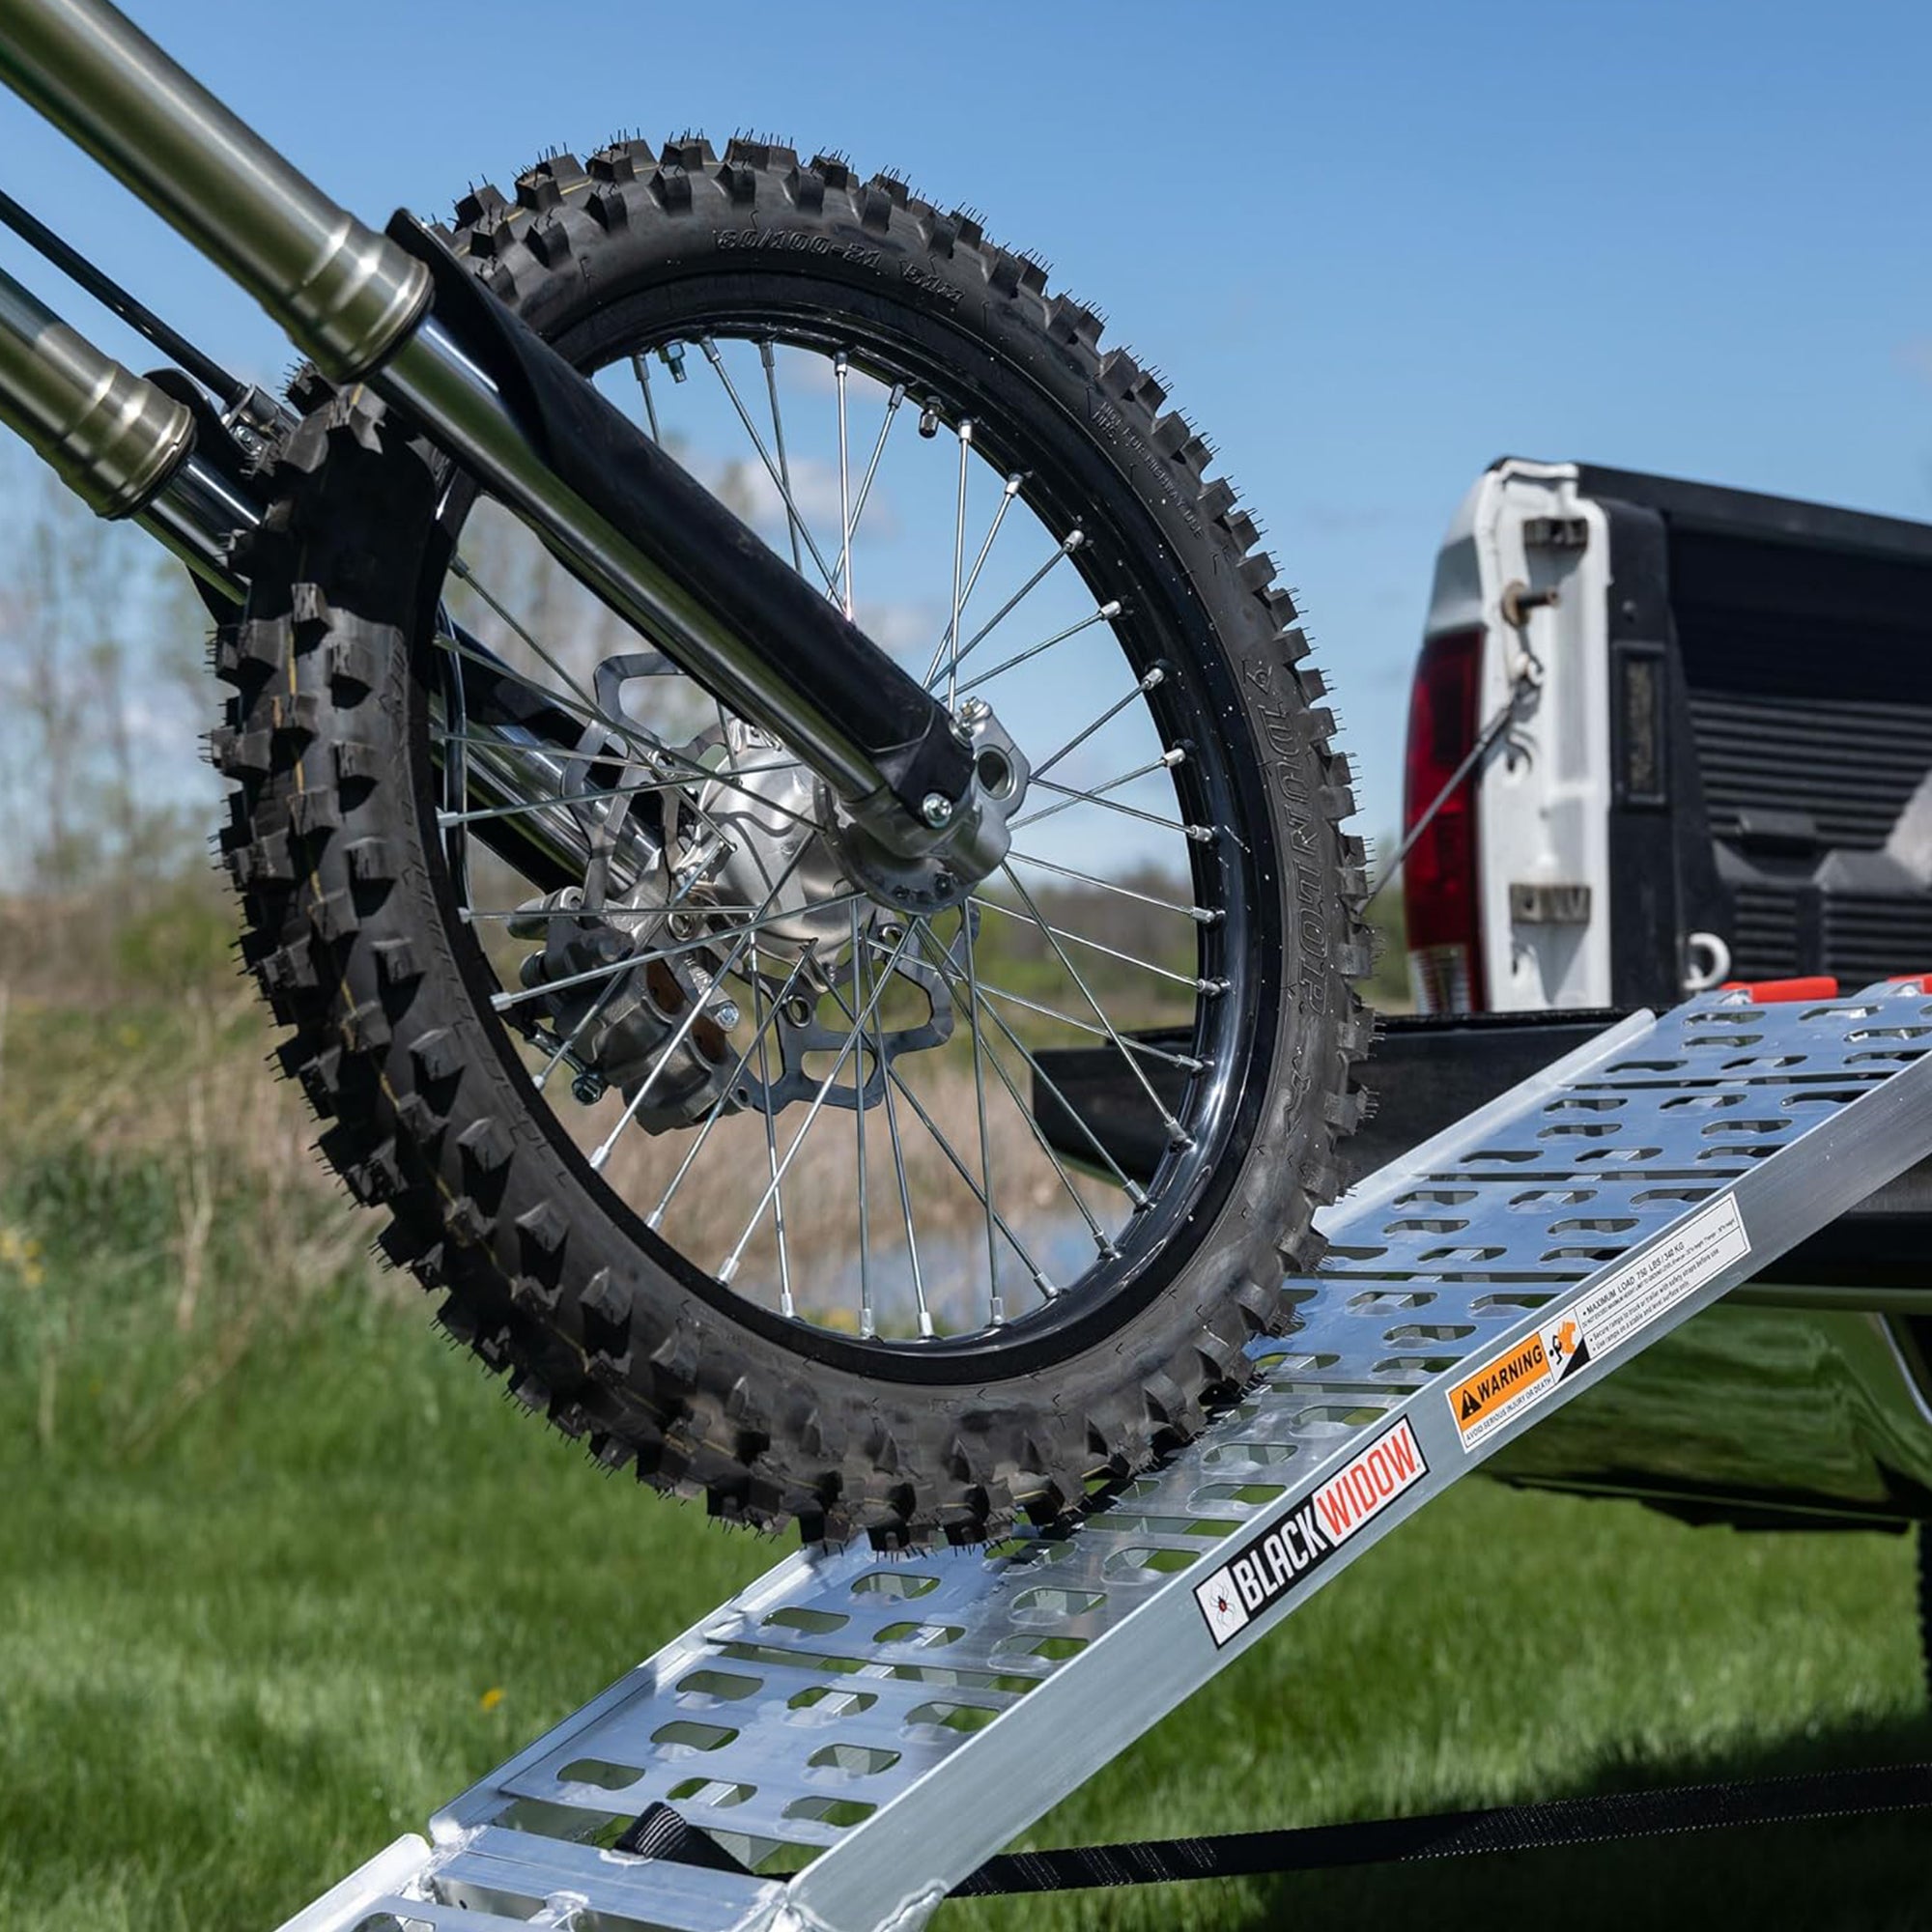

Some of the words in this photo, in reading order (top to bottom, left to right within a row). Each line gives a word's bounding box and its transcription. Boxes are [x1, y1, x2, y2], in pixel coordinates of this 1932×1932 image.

[1257, 703, 1330, 1015] DUNLOP
[1586, 1289, 1617, 1315] MAXIMUM
[1617, 1275, 1635, 1293] LOAD
[1476, 1344, 1543, 1403] WARNING
[1483, 1409, 1507, 1430] SERIOUS
[1533, 1378, 1552, 1394] DEATH
[1232, 1503, 1328, 1612] BLACK
[1316, 1427, 1418, 1536] WIDOW
